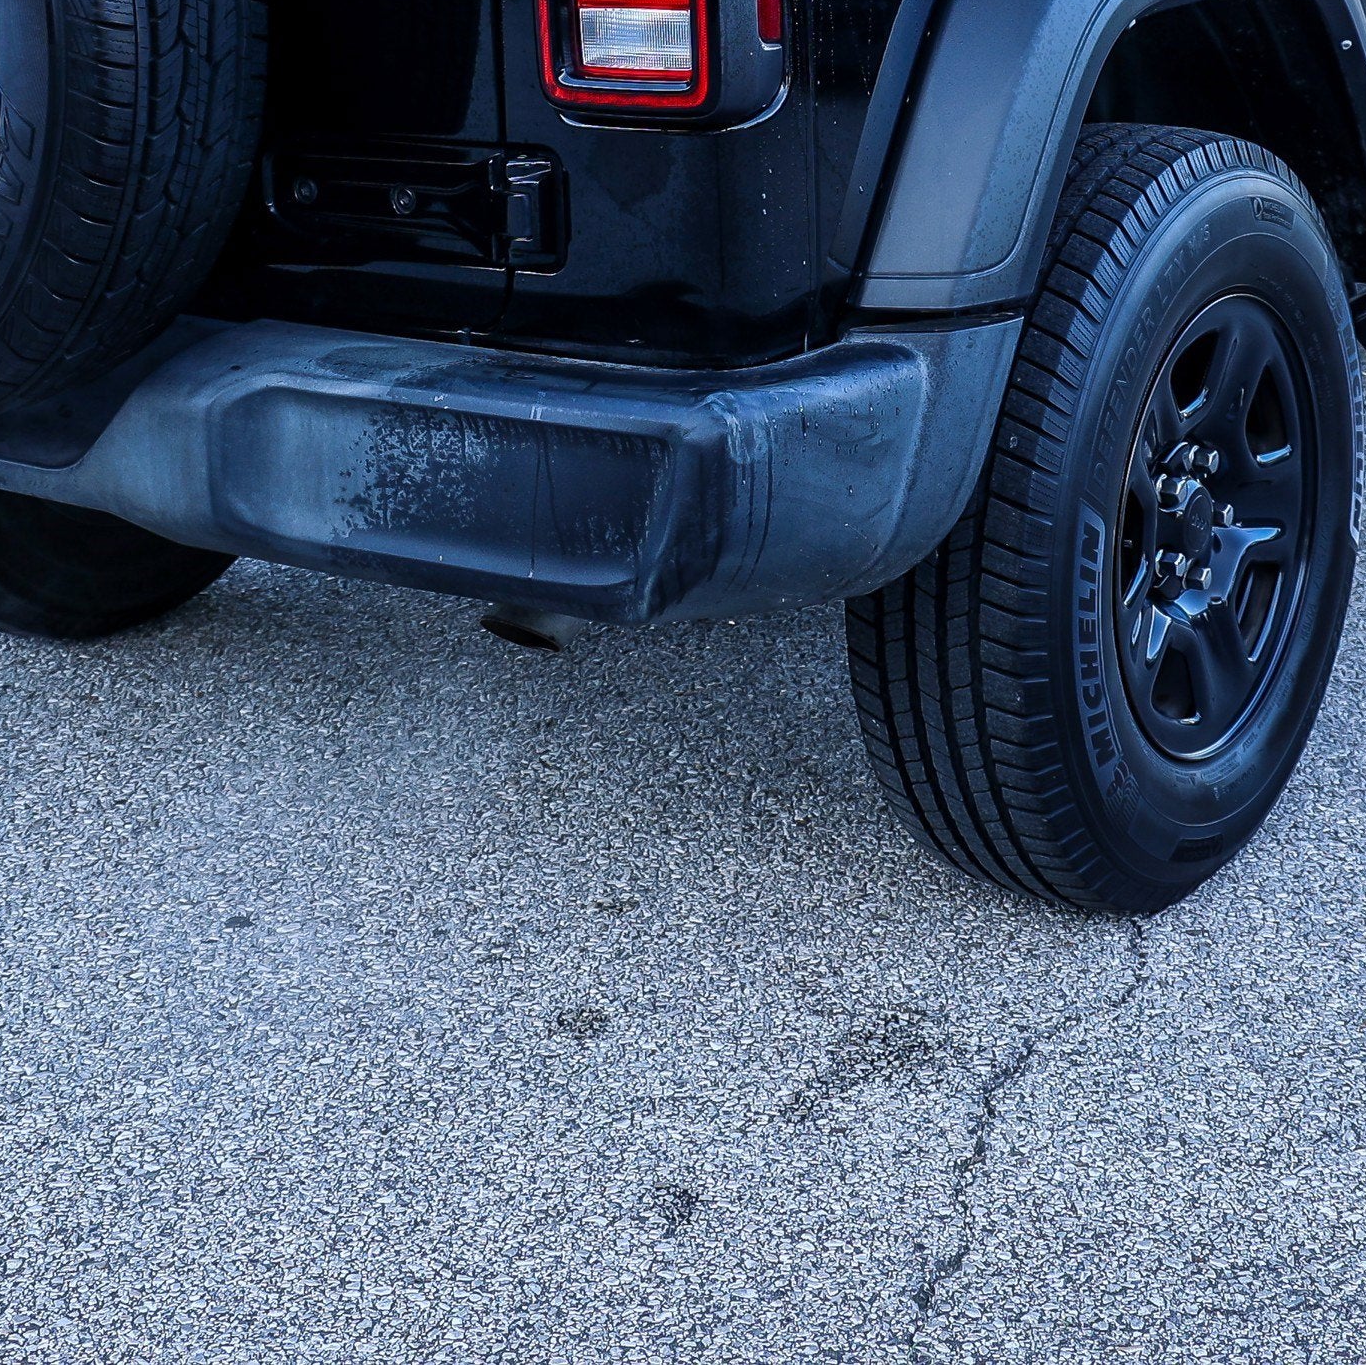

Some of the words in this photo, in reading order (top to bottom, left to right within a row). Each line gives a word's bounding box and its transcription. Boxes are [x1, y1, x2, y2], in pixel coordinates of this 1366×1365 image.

[1093, 307, 1155, 481] DEFENDER
[1343, 323, 1364, 531] MICHELIN
[1077, 519, 1118, 769] MICHELIN
